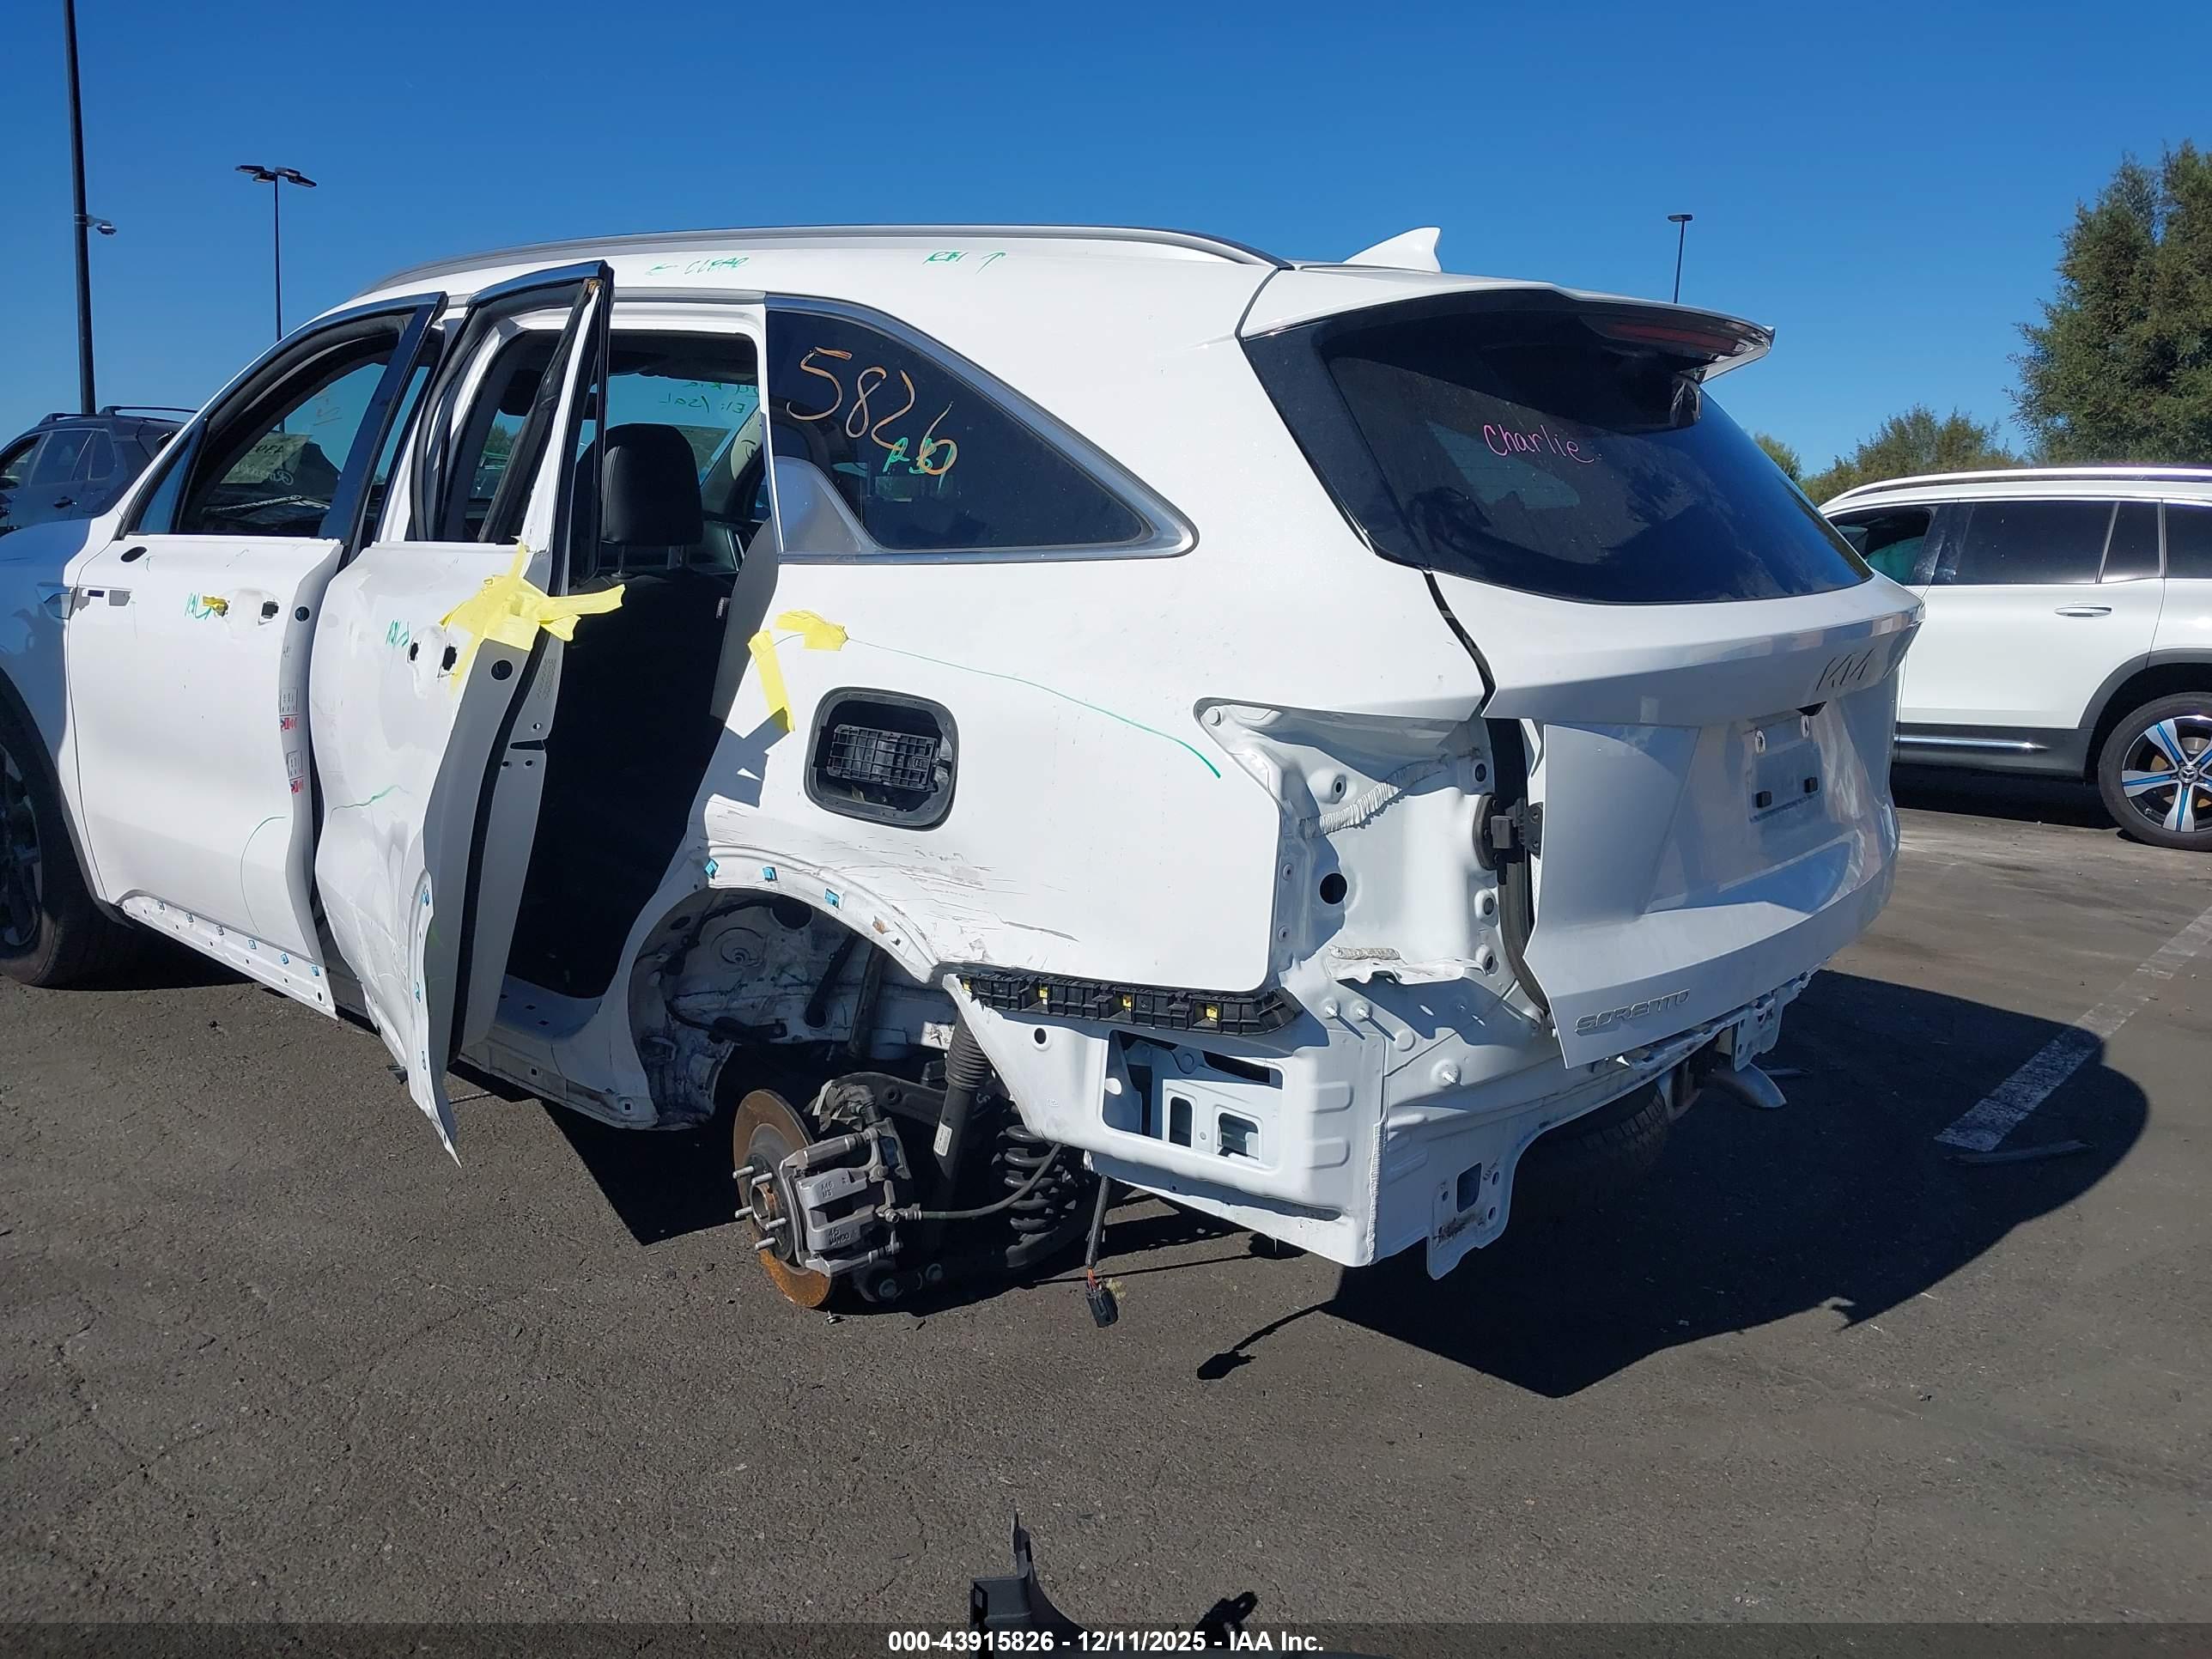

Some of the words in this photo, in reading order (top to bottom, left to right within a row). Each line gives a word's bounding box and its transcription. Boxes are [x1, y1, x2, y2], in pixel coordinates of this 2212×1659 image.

[786, 346, 958, 476] 5826
[1483, 423, 1595, 464] Charlie
[1574, 988, 1691, 1033] SORENTO
